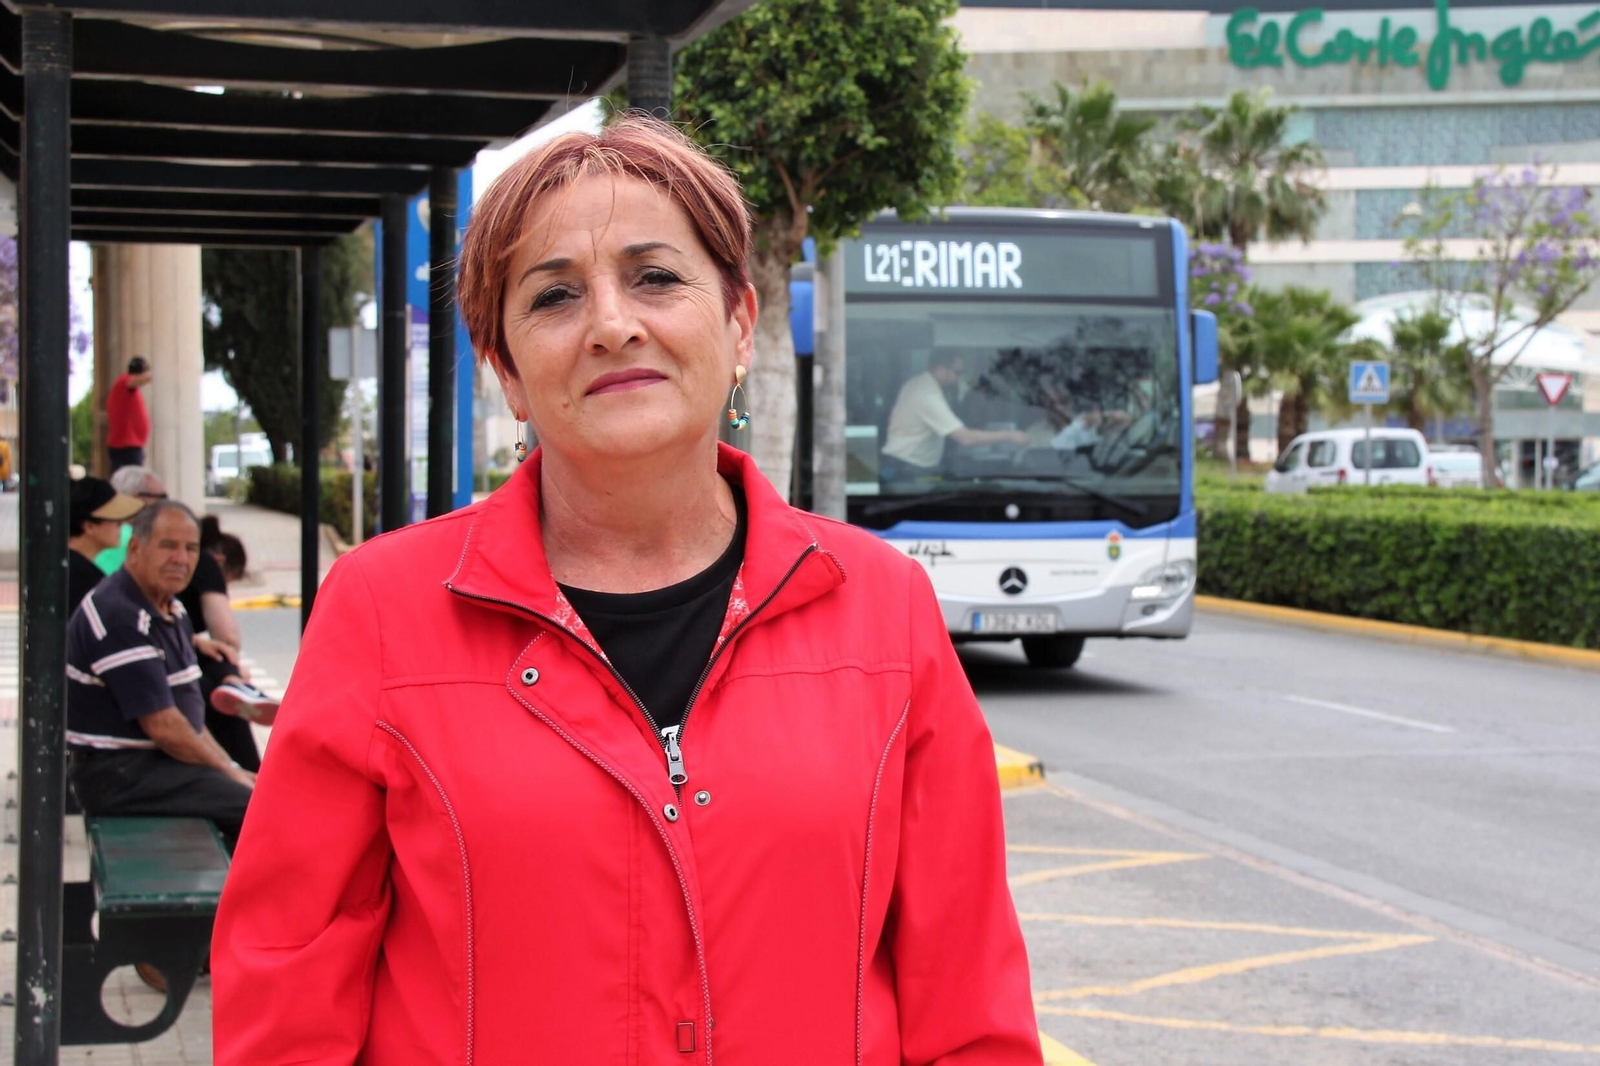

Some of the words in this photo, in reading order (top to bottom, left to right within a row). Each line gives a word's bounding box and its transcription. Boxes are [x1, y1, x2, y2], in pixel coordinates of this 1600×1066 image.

[1226, 6, 1284, 69] El
[1285, 8, 1420, 68] Corte
[1425, 0, 1600, 91] Inglé
[863, 243, 901, 283] L21
